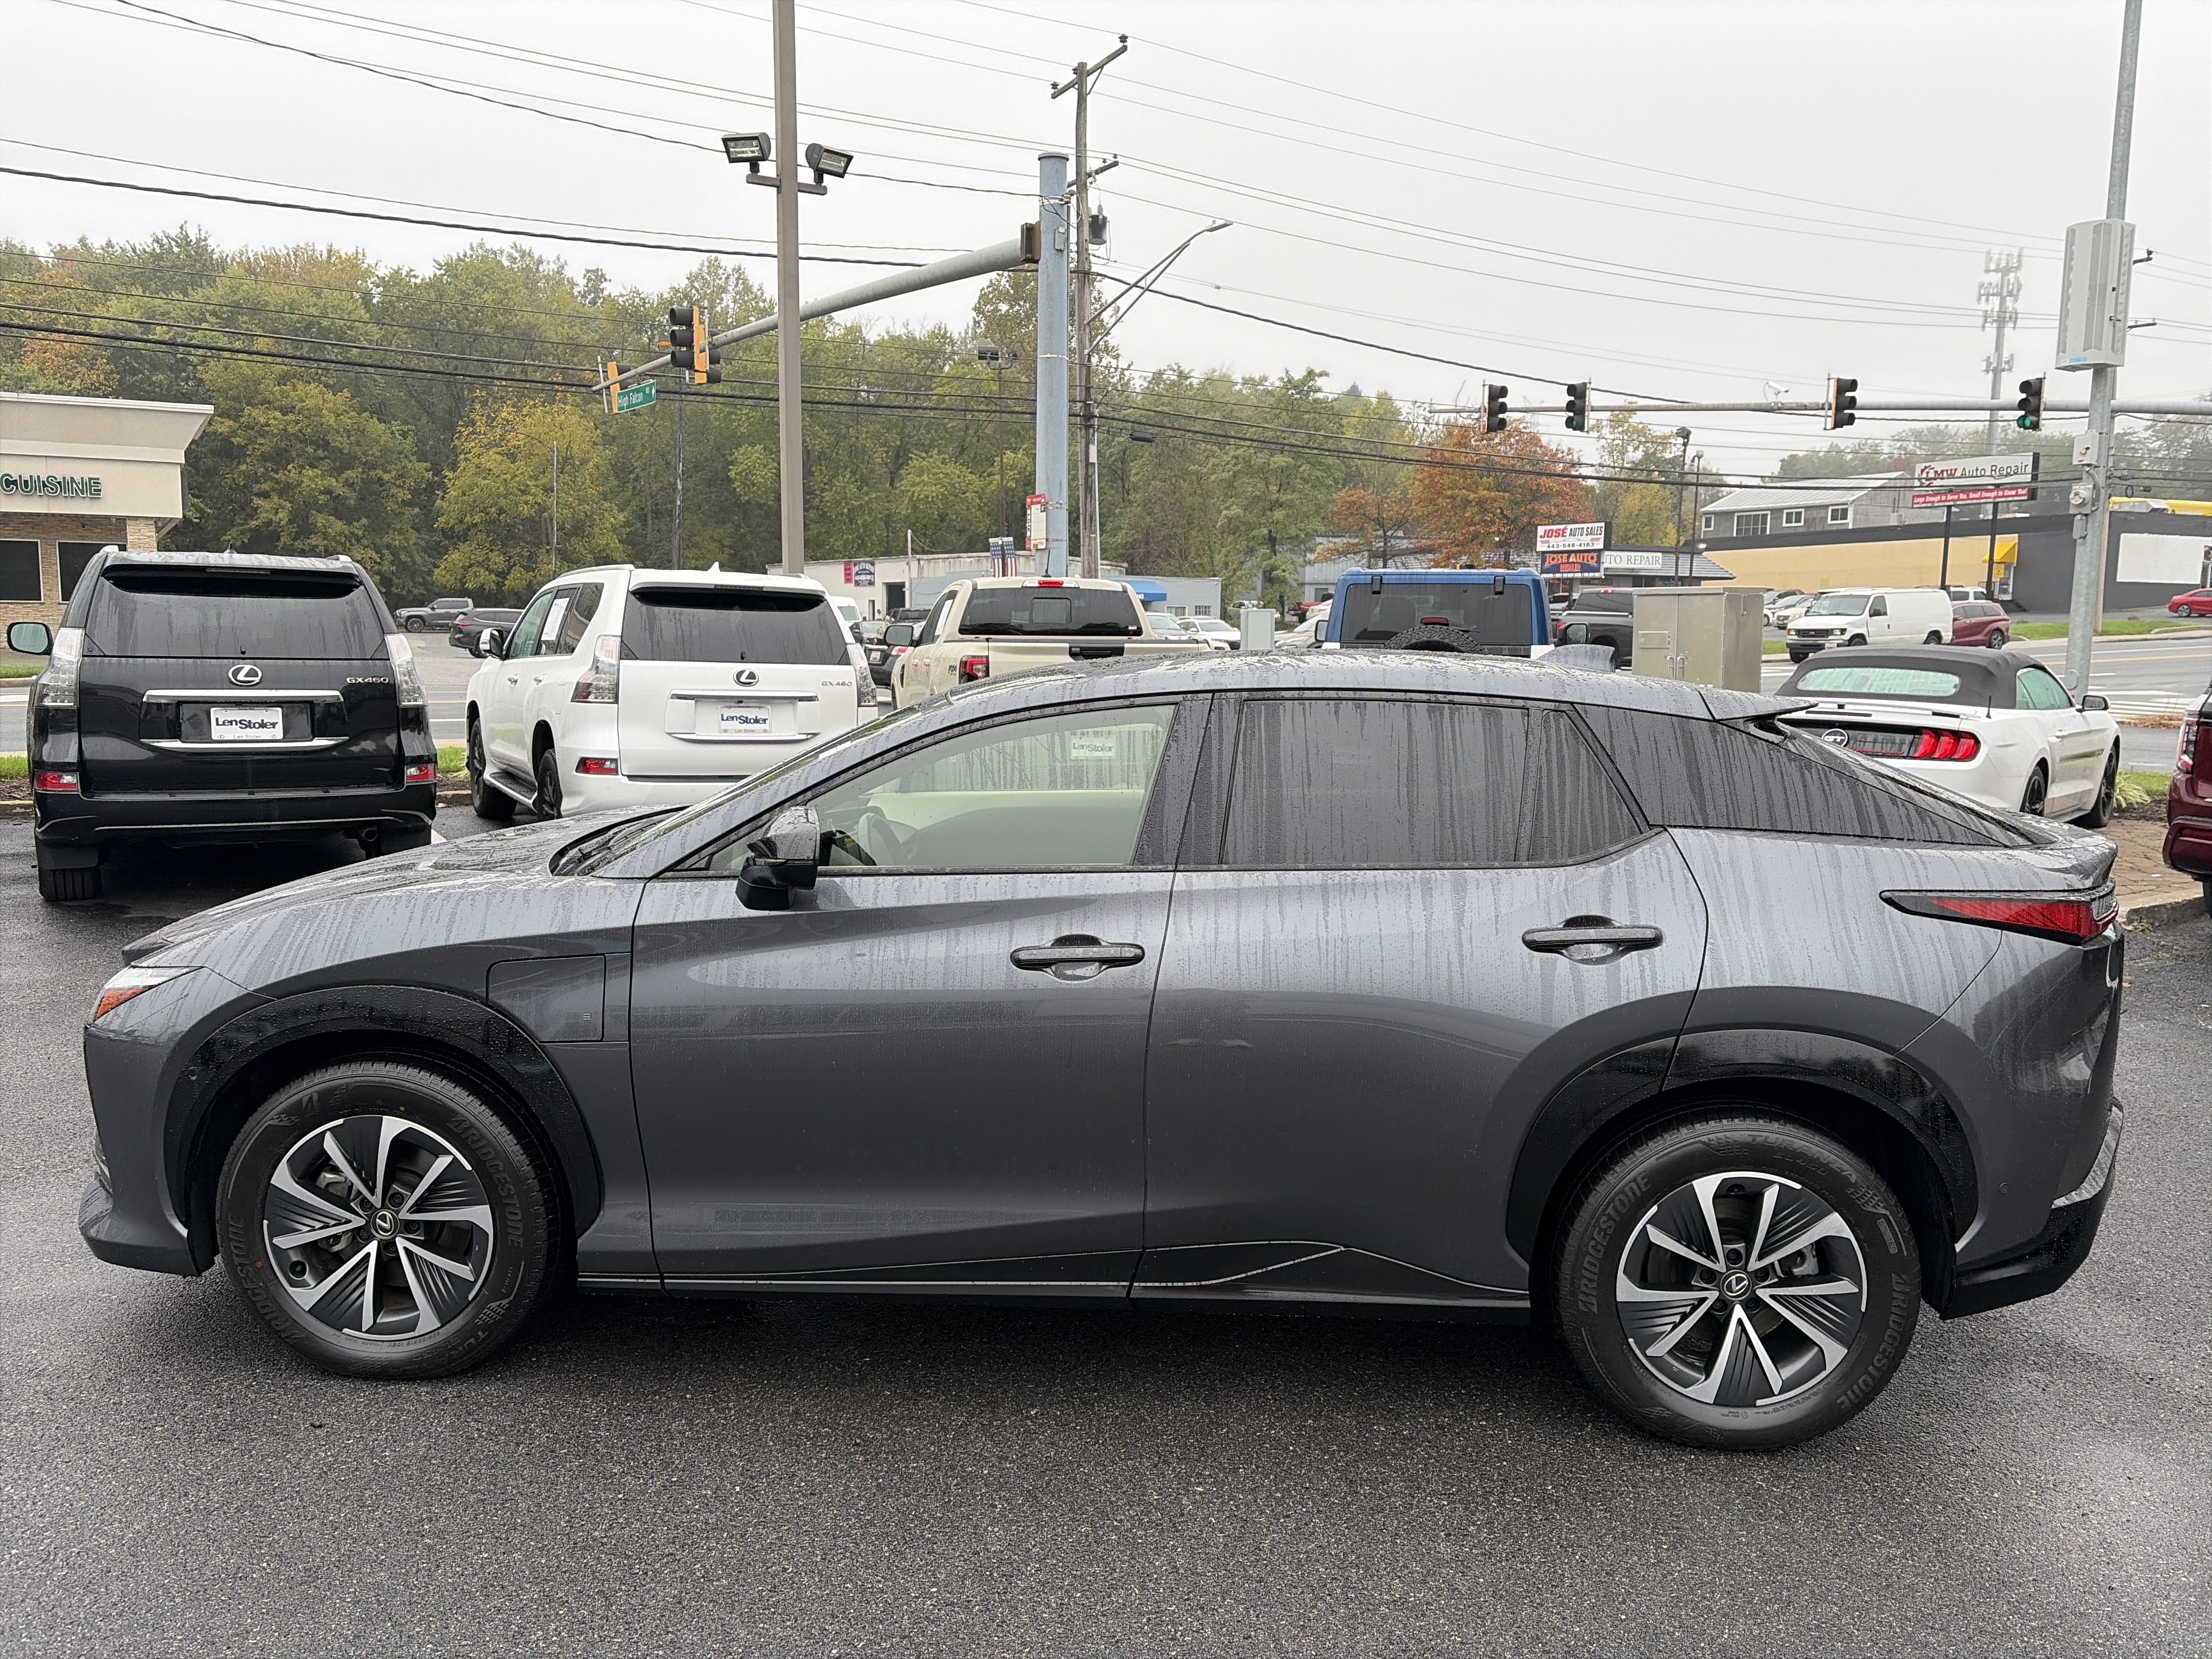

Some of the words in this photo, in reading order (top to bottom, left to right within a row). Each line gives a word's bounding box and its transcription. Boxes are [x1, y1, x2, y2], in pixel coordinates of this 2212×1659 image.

[618, 394, 629, 409] High
[629, 392, 644, 404] Falcon
[1960, 467, 1986, 477] Auto
[1990, 462, 2029, 476] Repair
[0, 473, 103, 498] CUISINE
[1539, 526, 1568, 538] JOSÉ
[1568, 527, 1584, 537] AUTO
[1585, 526, 1603, 536] SALES
[1545, 553, 1568, 566] JOSE
[1569, 552, 1598, 564] AUTO
[1627, 555, 1661, 565] REPAIR
[447, 1114, 523, 1248] BRIDGESTONE
[1578, 1170, 1651, 1314] BRIDGESTONE
[1837, 1272, 1910, 1409] BRIDGESTONE
